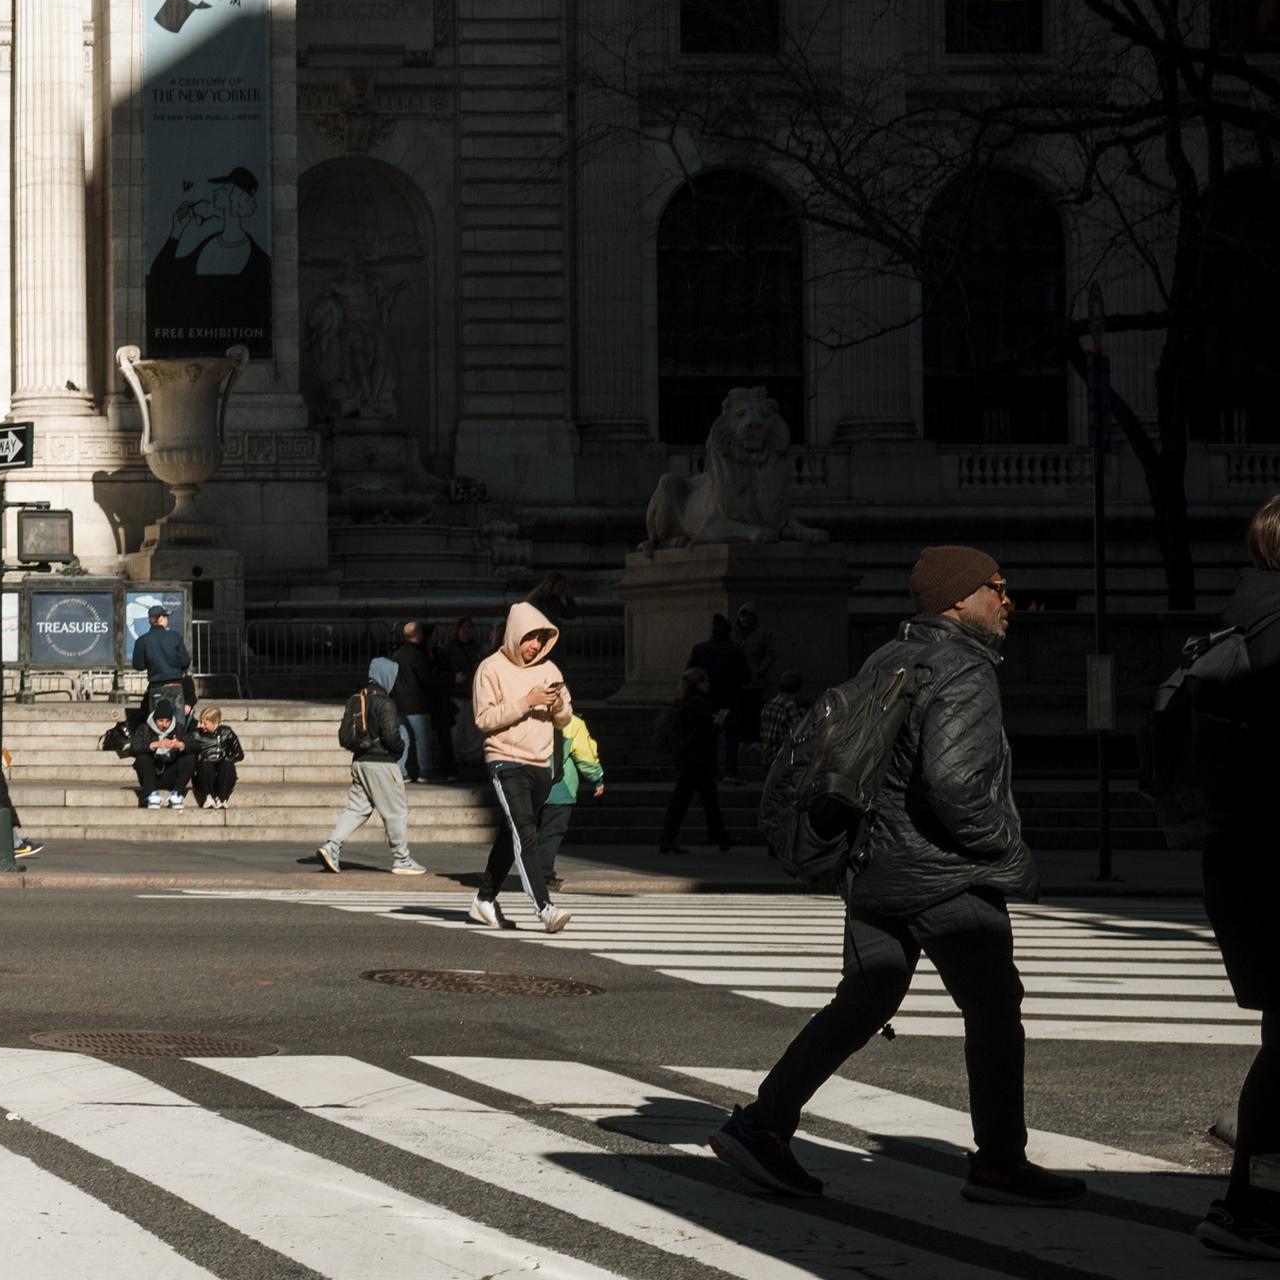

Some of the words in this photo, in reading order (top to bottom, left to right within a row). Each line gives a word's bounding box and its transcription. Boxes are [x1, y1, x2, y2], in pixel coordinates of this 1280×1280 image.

[178, 78, 226, 86] CENTURY
[229, 78, 241, 86] OF
[153, 89, 174, 102] THE
[177, 89, 207, 102] NEW
[210, 89, 262, 102] YORKER
[154, 328, 185, 339] FREE
[188, 328, 264, 339] EXHIBITION
[36, 621, 109, 633] TREASURES
